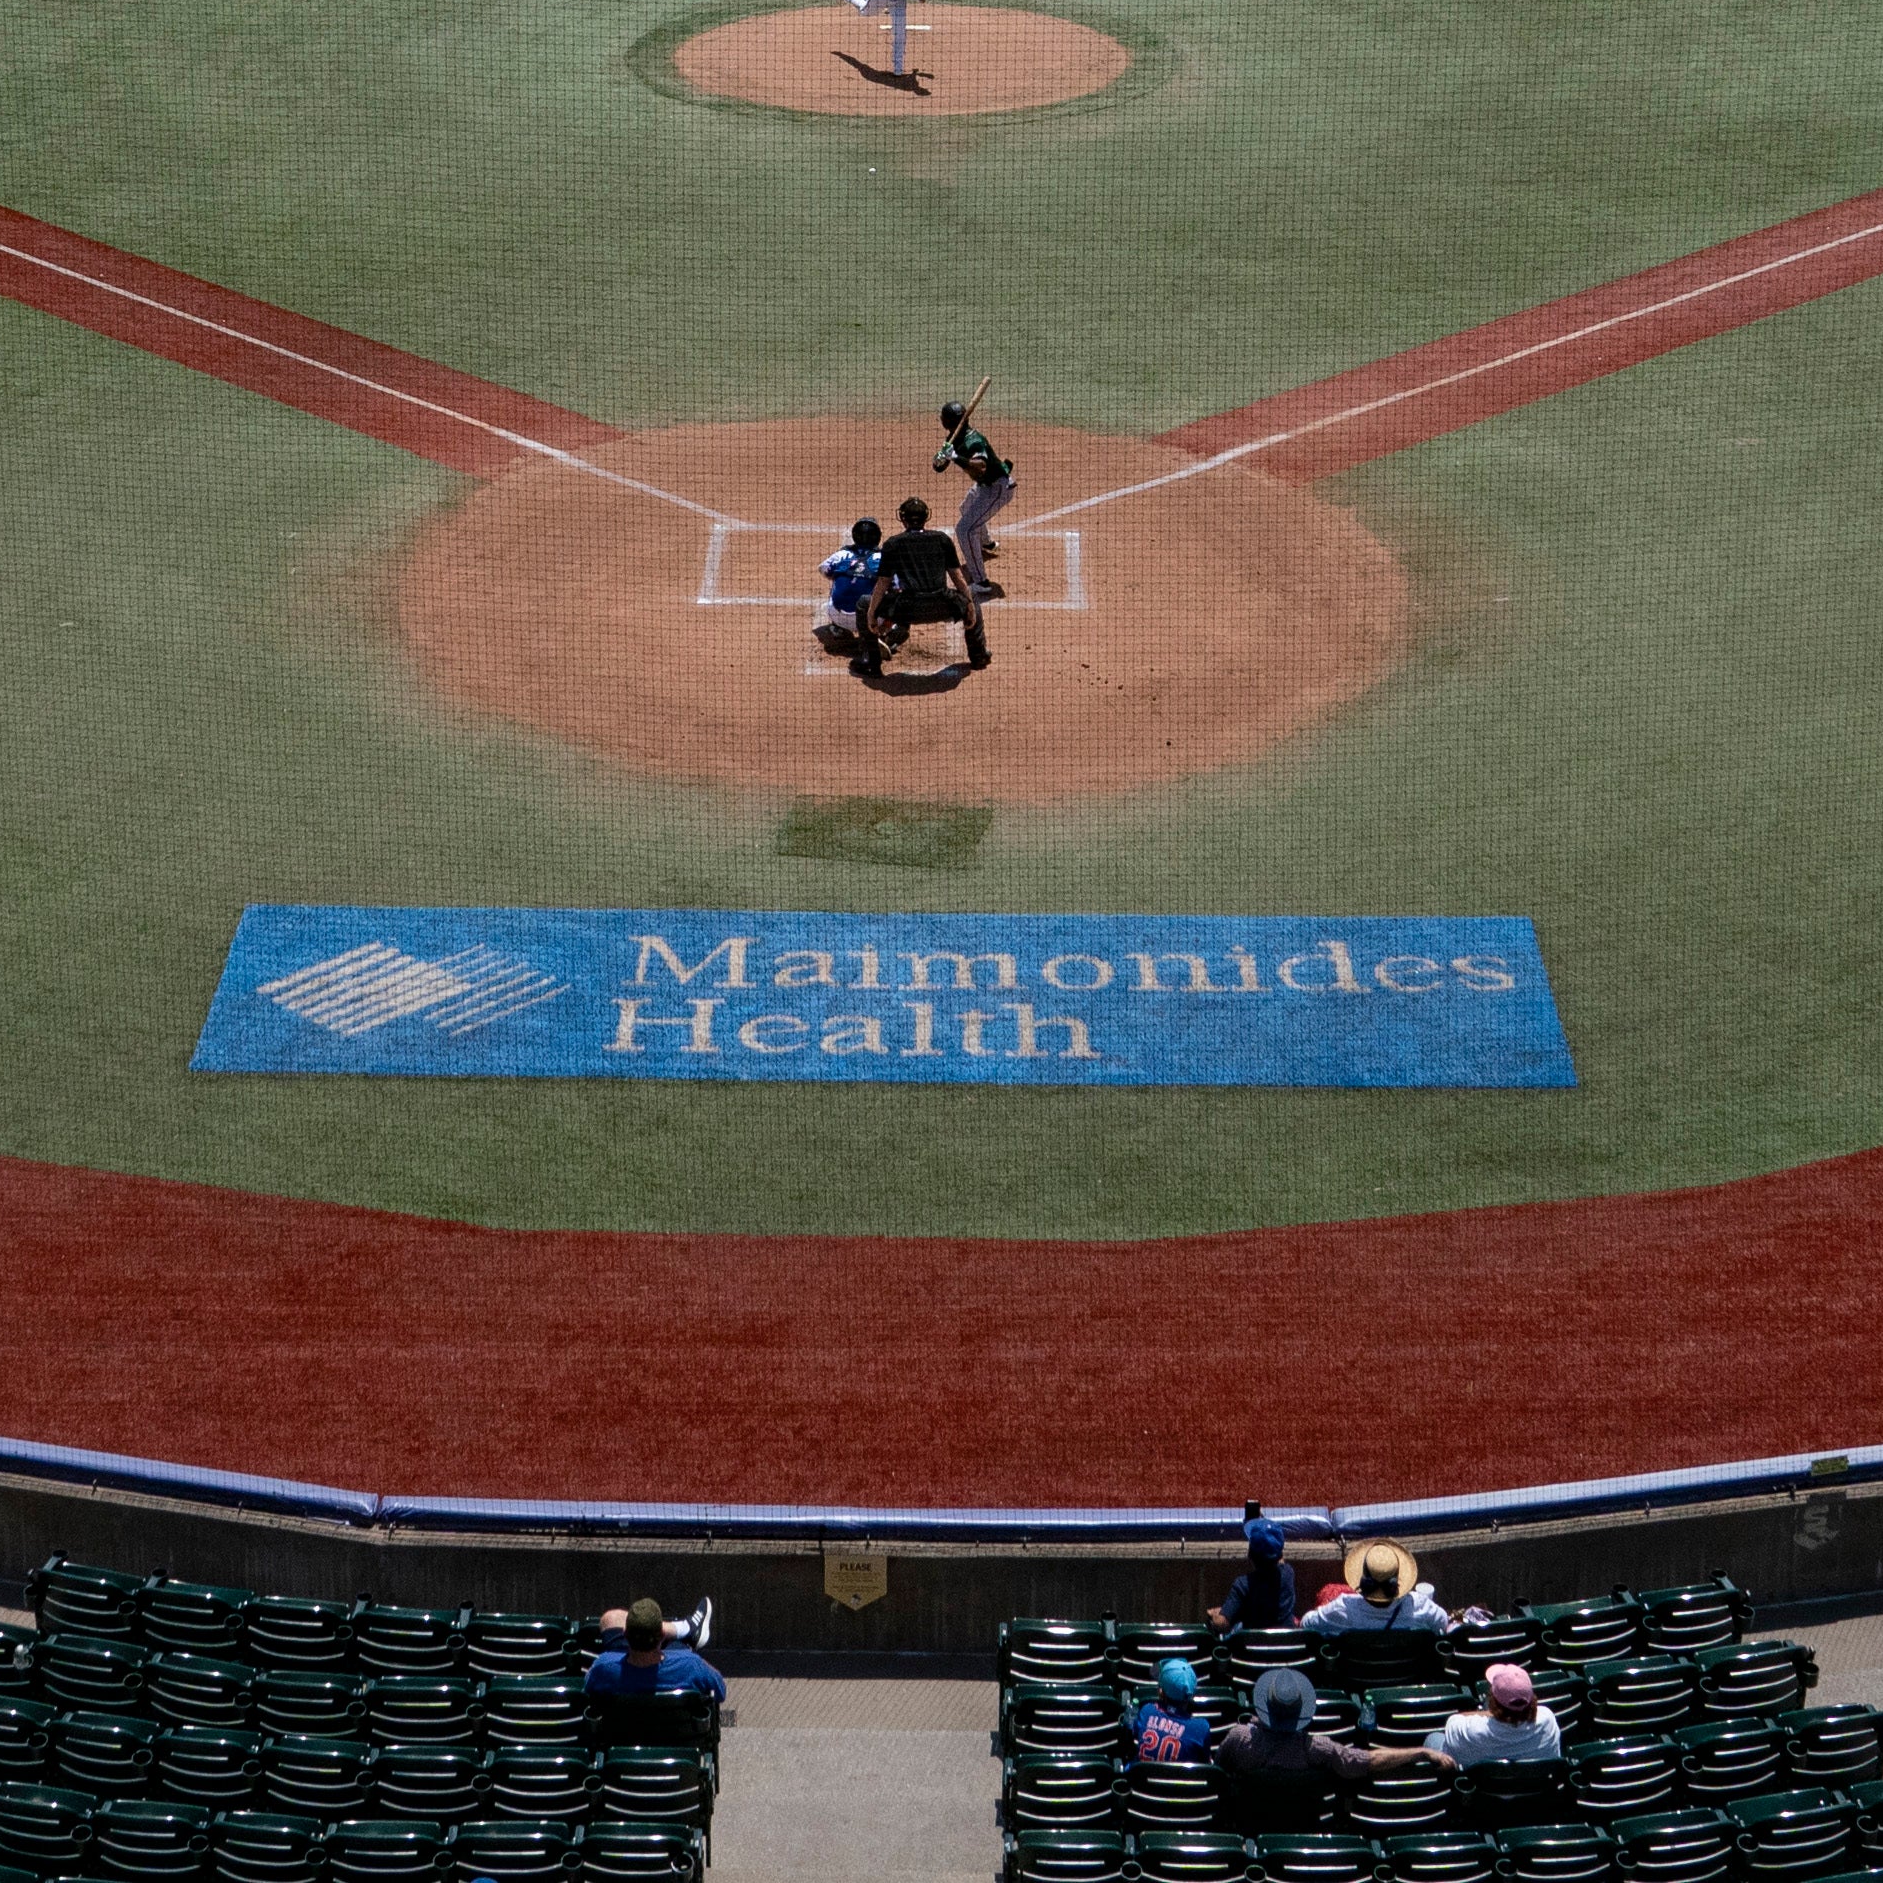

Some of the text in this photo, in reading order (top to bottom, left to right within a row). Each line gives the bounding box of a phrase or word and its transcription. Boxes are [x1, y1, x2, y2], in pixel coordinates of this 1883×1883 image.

[622, 933, 1518, 995] Maimonides
[600, 995, 1103, 1060] Health
[839, 1562, 871, 1572] PLEASE
[1140, 1728, 1182, 1762] 20
